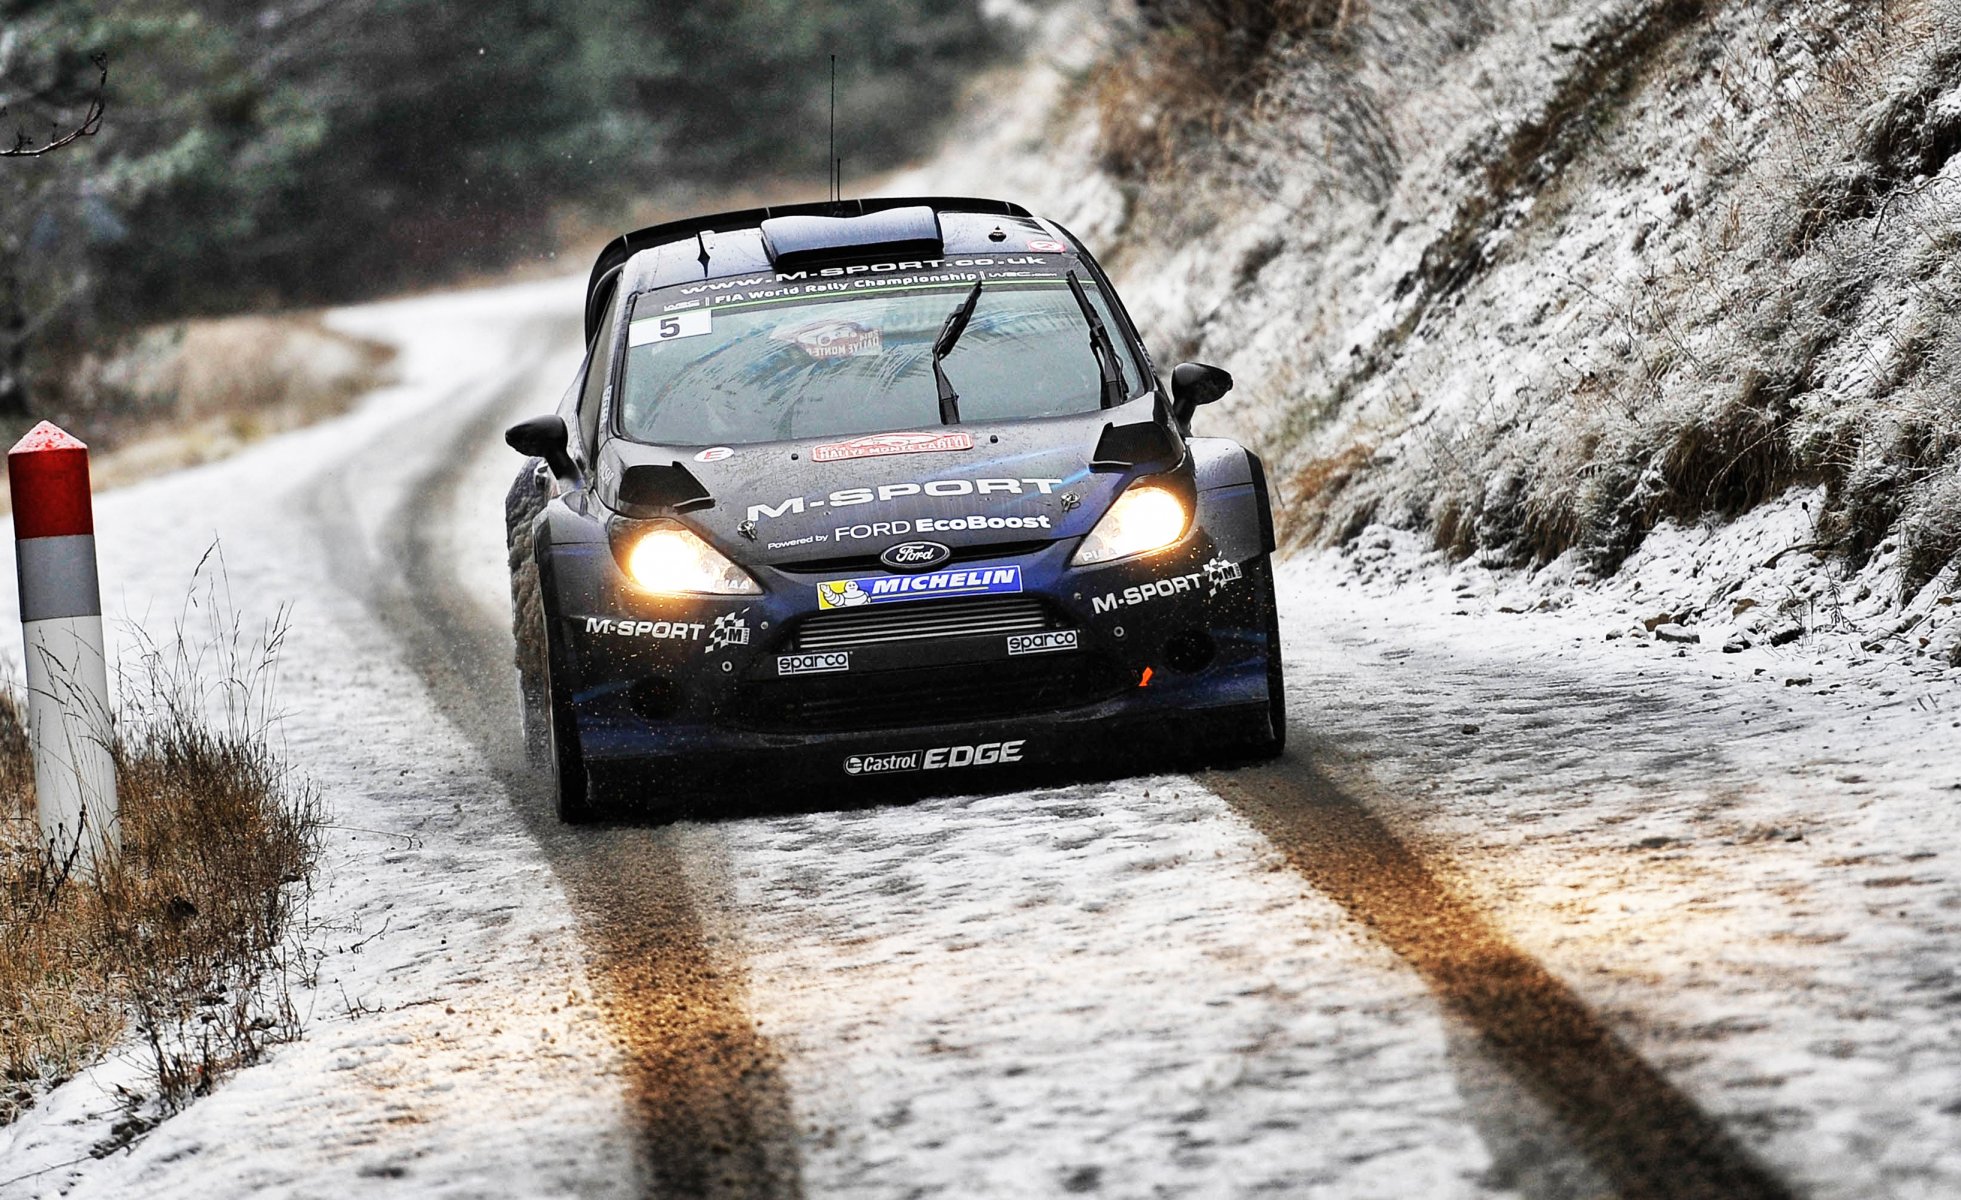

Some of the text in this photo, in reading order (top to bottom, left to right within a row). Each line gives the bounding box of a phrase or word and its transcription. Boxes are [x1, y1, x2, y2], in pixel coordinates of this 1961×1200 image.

[680, 256, 1047, 295] www.M-SPORT.co.uk
[715, 294, 744, 304] FIA
[749, 287, 800, 299] World
[805, 282, 848, 293] Rally
[854, 272, 977, 288] Championship
[659, 317, 680, 338] 5
[747, 478, 1063, 522] M-SPORT
[768, 514, 1051, 550] Powered by FORD EcoBoost
[895, 547, 935, 562] Ford
[871, 569, 1016, 594] MICHELIN
[1091, 573, 1202, 615] M-SPORT
[585, 617, 706, 641] M-SPORT
[727, 629, 742, 644] M
[1008, 632, 1077, 653] sparco
[778, 653, 848, 672] sparco
[863, 739, 1027, 773] Castrol EDGE
